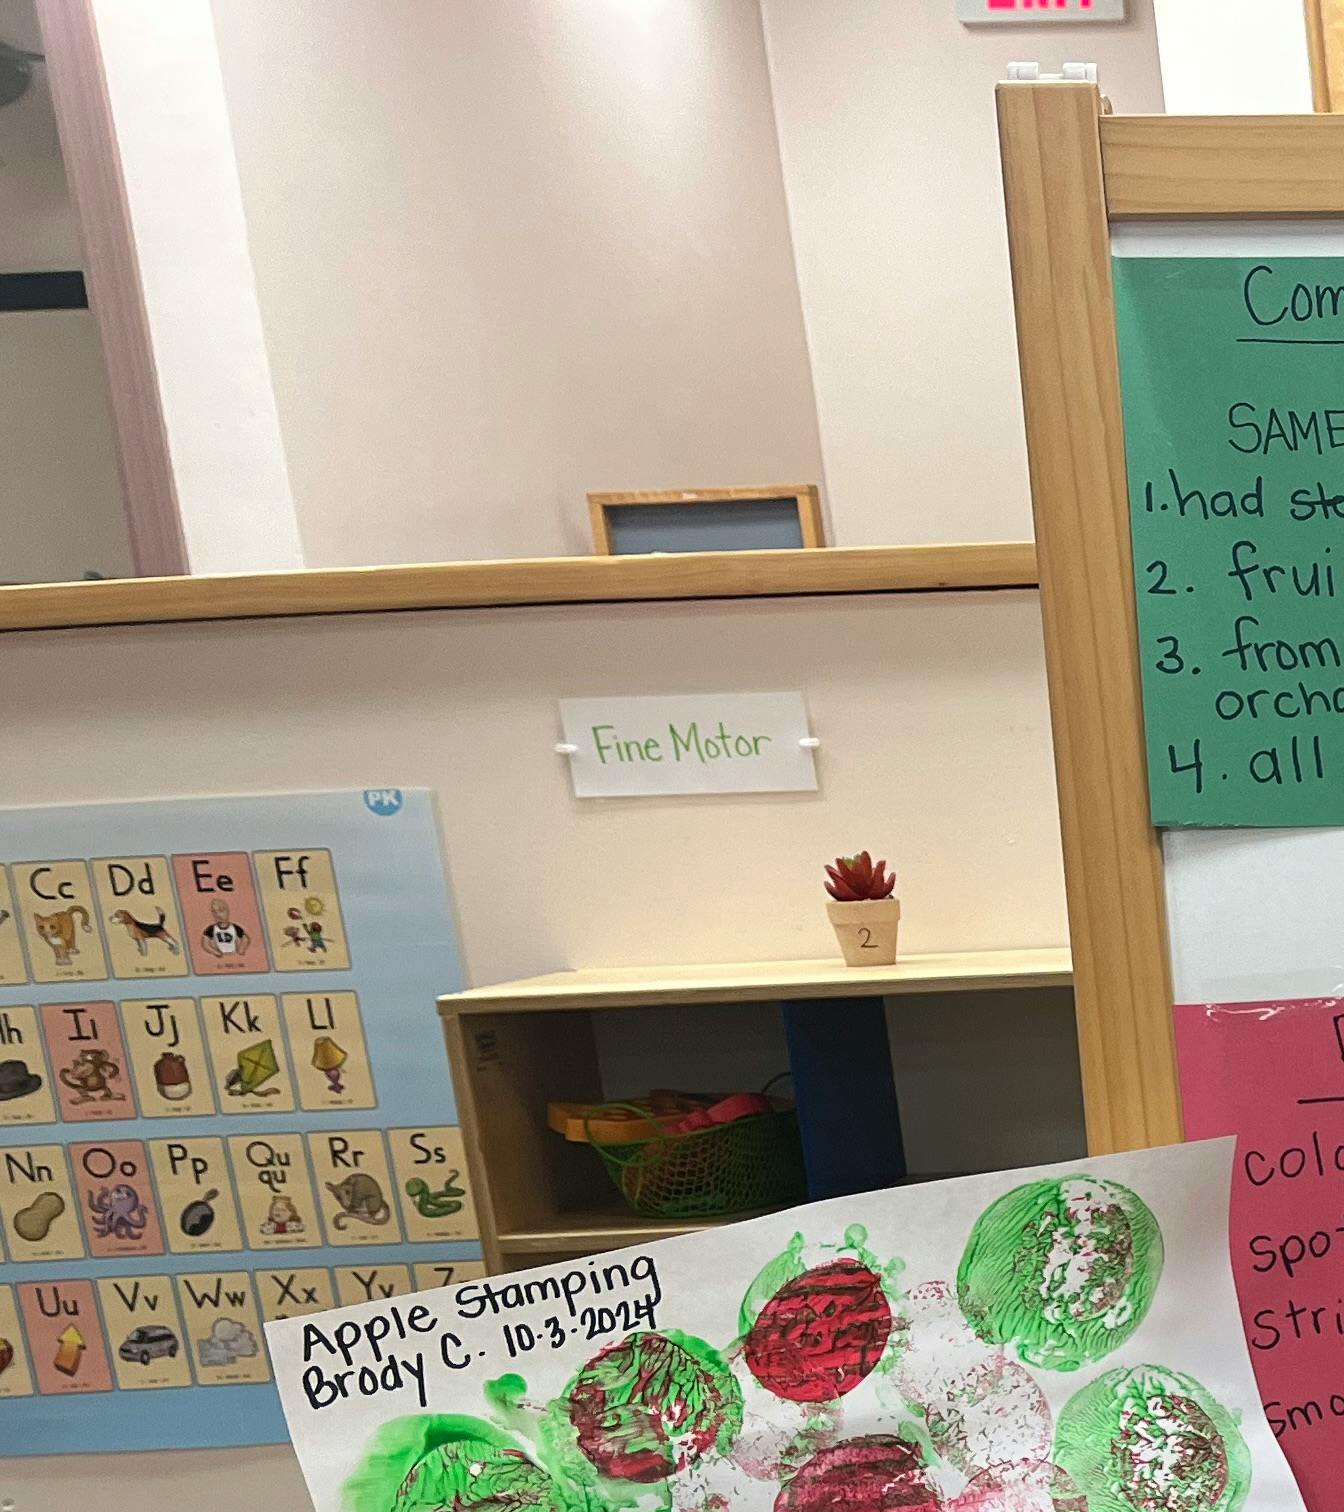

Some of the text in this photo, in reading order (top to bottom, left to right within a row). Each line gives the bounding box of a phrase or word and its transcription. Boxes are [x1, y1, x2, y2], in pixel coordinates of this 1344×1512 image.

[1147, 561, 1194, 596] 2.
[1156, 636, 1200, 676] 3.
[1222, 616, 1341, 673] from
[591, 721, 772, 764] Fine Motor
[1167, 737, 1228, 793] 4.
[1249, 736, 1323, 785] all
[367, 790, 399, 807] PK
[30, 867, 75, 900] Cc
[108, 862, 155, 896] Dd
[192, 860, 234, 893] Ee
[275, 855, 310, 889] Ff
[858, 927, 878, 948] 2
[219, 1000, 262, 1034] Kk
[82, 1147, 137, 1179] Oo
[166, 1143, 208, 1184] Pp
[245, 1140, 291, 1173] Qu
[327, 1136, 365, 1169] Rr
[410, 1133, 446, 1165] Ss
[5, 1151, 52, 1185] Nn
[35, 1286, 80, 1318] Uu
[114, 1281, 158, 1313] Vv
[184, 1277, 247, 1310] Ww
[272, 1274, 320, 1306] Xx
[303, 1255, 662, 1366] Apple Stamping
[302, 1353, 427, 1408] Brody
[440, 1333, 486, 1369] C.
